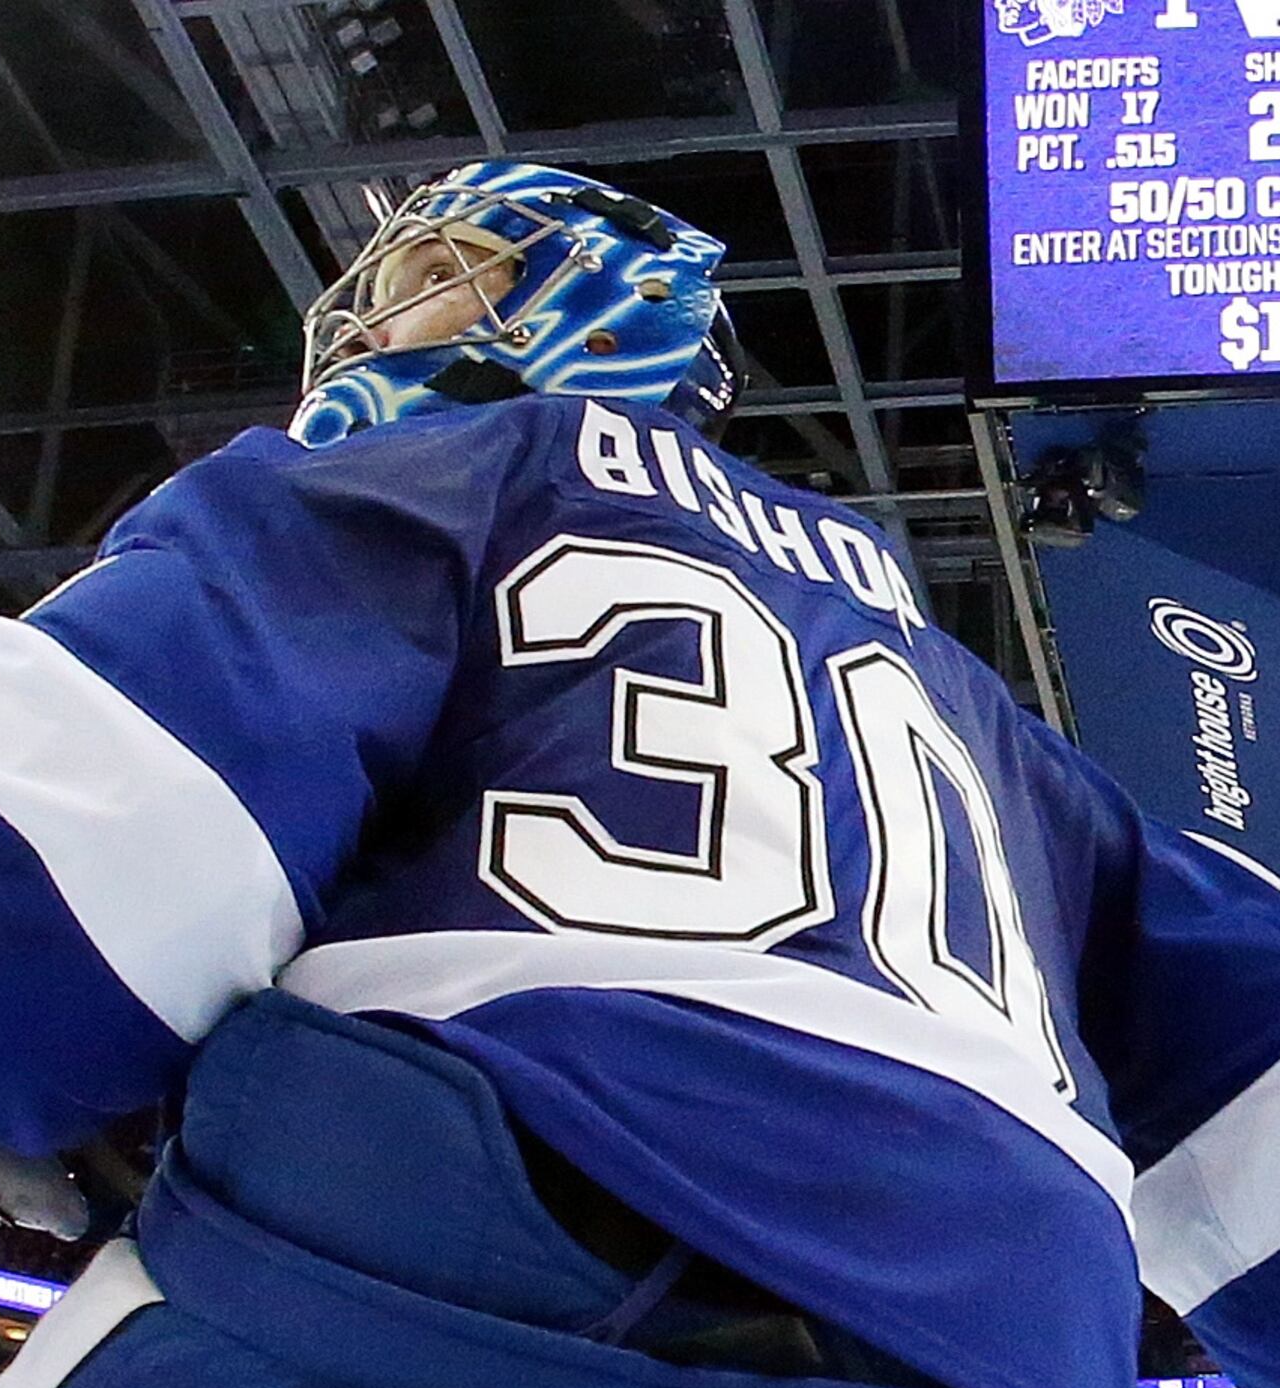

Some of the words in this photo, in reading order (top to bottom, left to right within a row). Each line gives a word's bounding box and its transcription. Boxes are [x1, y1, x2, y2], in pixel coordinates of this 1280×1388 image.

[1027, 56, 1160, 91] FACEOFFS
[1014, 92, 1089, 130] WON
[1121, 91, 1160, 125] 17
[1017, 134, 1085, 172] PCT.
[1105, 133, 1177, 169] .515
[1109, 177, 1247, 225] 50/50
[1013, 229, 1103, 266] ENTER
[1106, 228, 1142, 261] AT
[478, 533, 1077, 1102] 30
